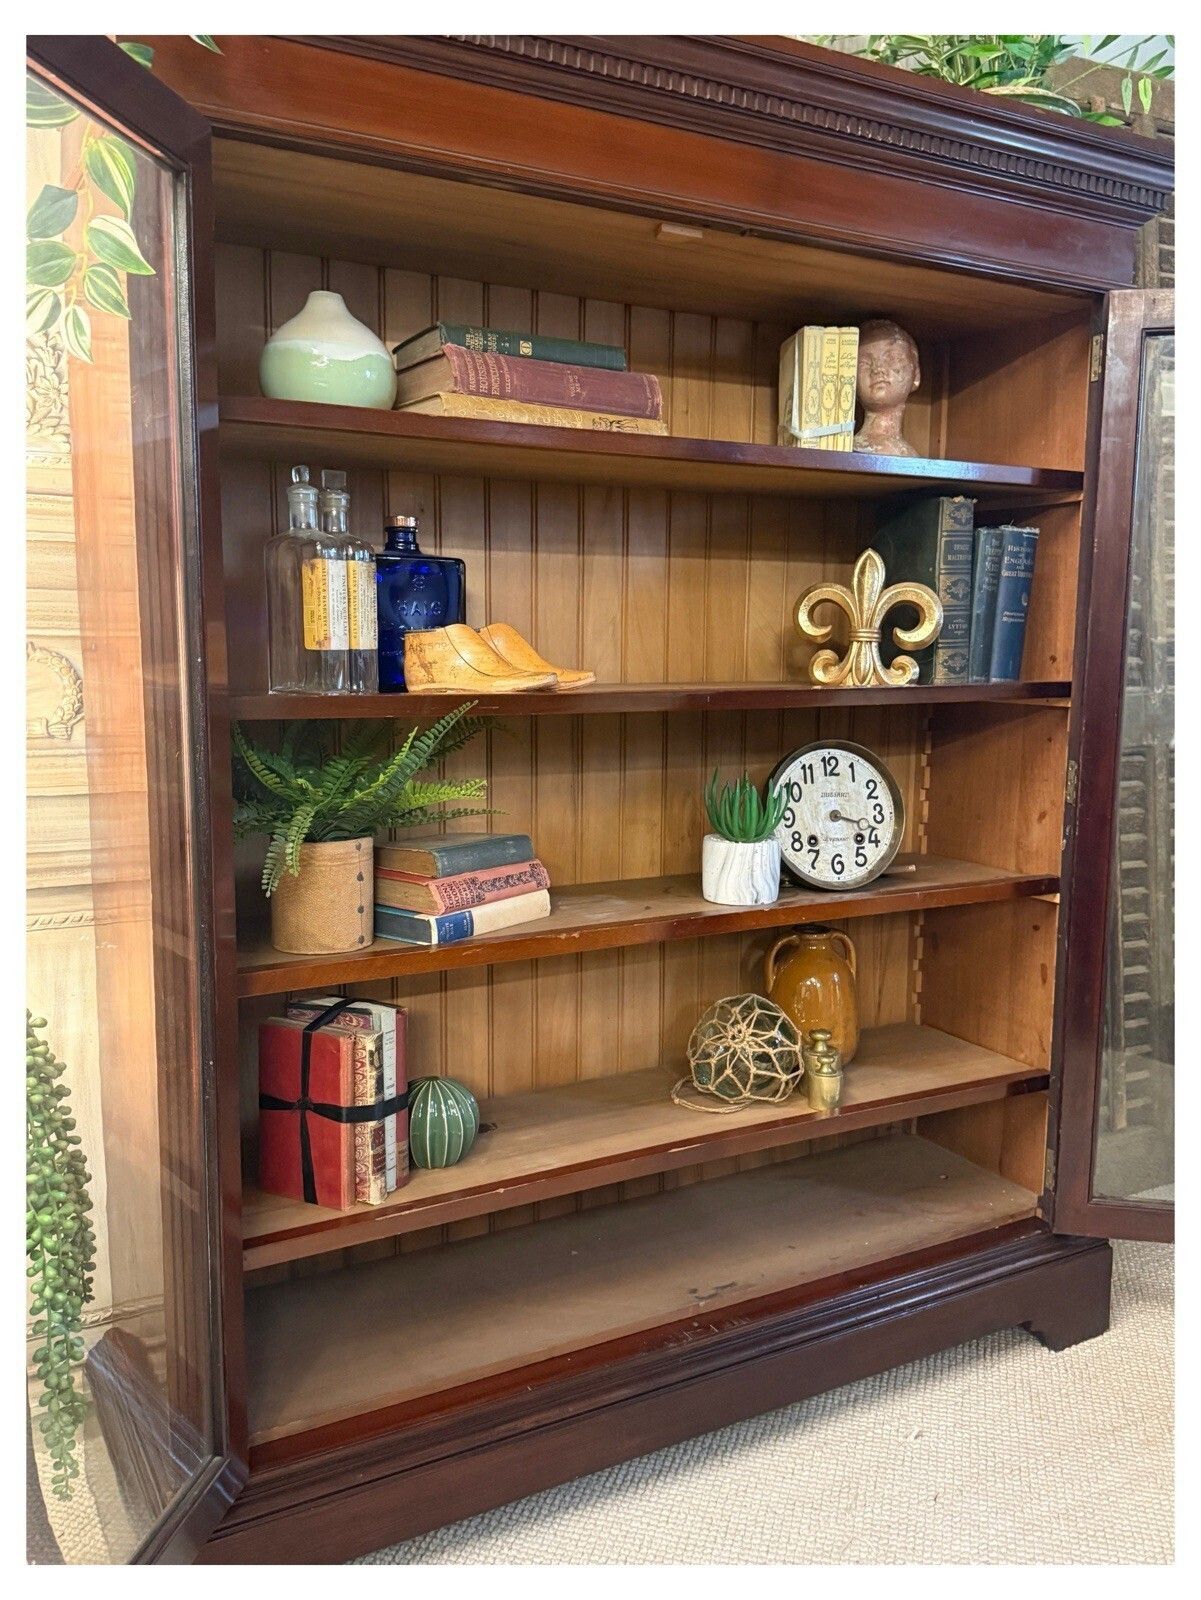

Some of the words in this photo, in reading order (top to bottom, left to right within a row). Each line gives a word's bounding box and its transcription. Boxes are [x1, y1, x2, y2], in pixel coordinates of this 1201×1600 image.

[801, 763, 815, 785] 11
[821, 756, 841, 777] 12
[848, 762, 856, 783] 1
[865, 779, 879, 800] 2
[783, 807, 796, 828] 9
[873, 803, 885, 824] 3
[791, 831, 804, 852] 8
[868, 827, 881, 848] 4
[807, 849, 820, 870] 7
[831, 853, 845, 875] 6
[855, 846, 868, 868] 5
[440, 883, 454, 910] LORNA
[446, 882, 461, 907] DOONE
